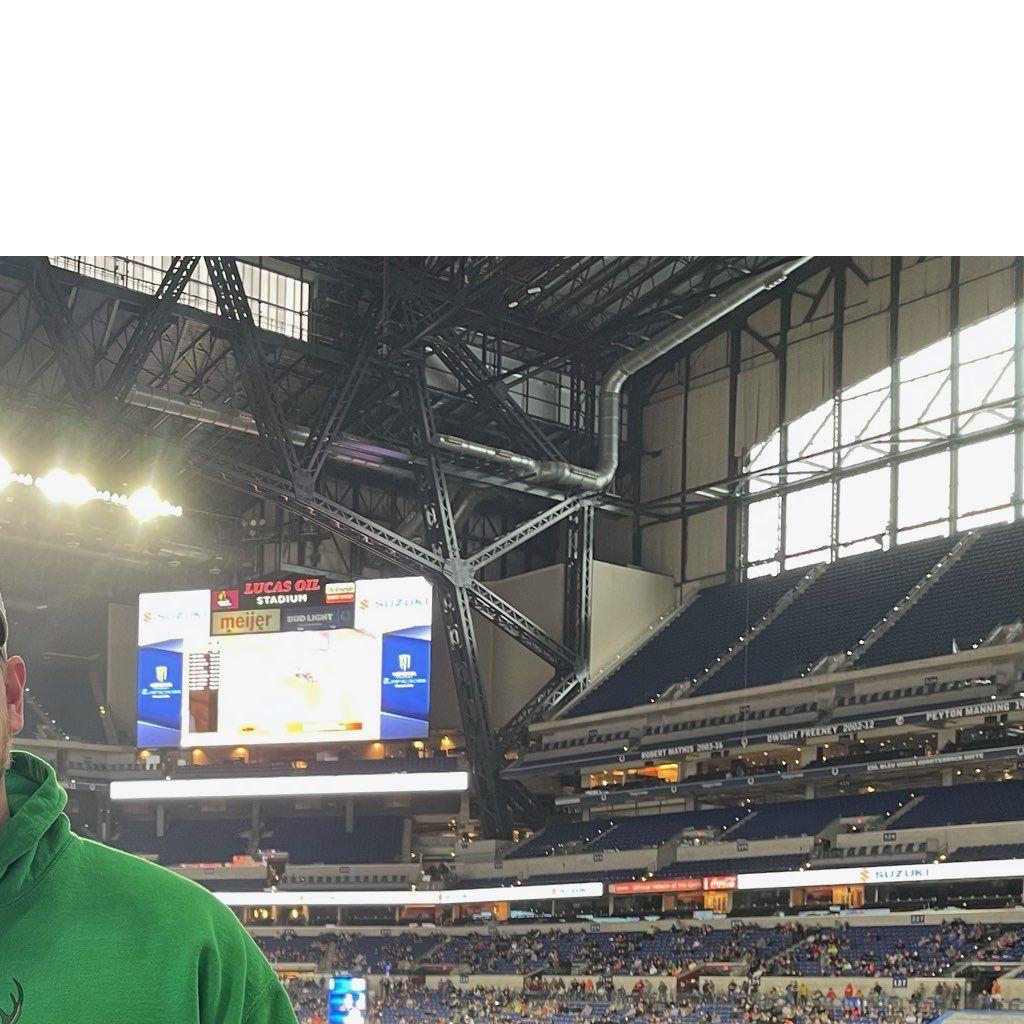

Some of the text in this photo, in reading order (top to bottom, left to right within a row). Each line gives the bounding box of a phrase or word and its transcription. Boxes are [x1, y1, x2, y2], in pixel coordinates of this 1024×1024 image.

[244, 581, 292, 595] LUCAS
[294, 579, 320, 592] OIL
[256, 594, 307, 605] STADIUM
[375, 598, 429, 607] SUZUKI
[220, 611, 272, 631] meijer
[286, 613, 333, 623] BUD LIGHT
[926, 710, 963, 722] PEYTON
[965, 701, 1010, 717] MANNING
[766, 730, 798, 743] DWIGHT
[876, 868, 929, 878] SUZUKI
